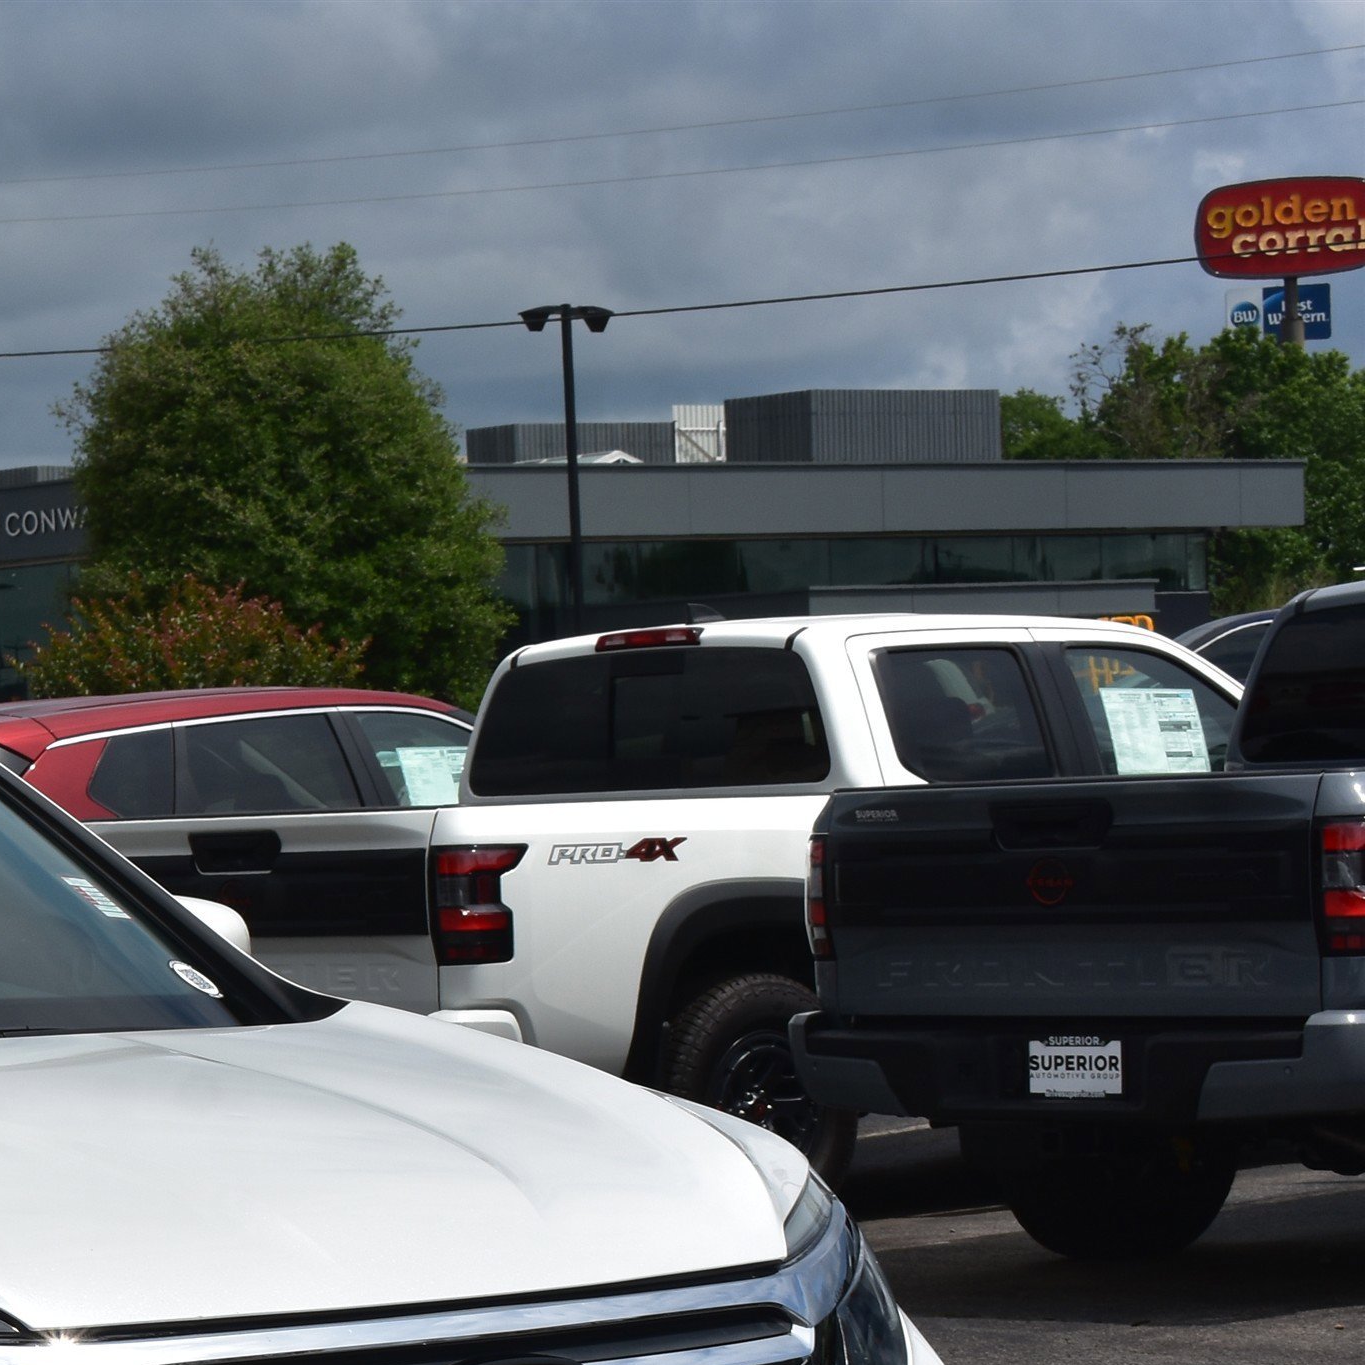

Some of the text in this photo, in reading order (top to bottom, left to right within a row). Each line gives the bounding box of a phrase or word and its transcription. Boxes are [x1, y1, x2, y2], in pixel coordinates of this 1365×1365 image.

[1207, 193, 1357, 239] golden
[1231, 218, 1365, 258] corral
[1233, 309, 1257, 323] BW
[1267, 311, 1325, 325] Wern
[854, 809, 898, 819] SUPERIOR
[1048, 1036, 1100, 1046] SUPERIOR
[1029, 1055, 1119, 1071] SUPERIOR
[1029, 1072, 1120, 1080] AUTOMOTIVE GROUP
